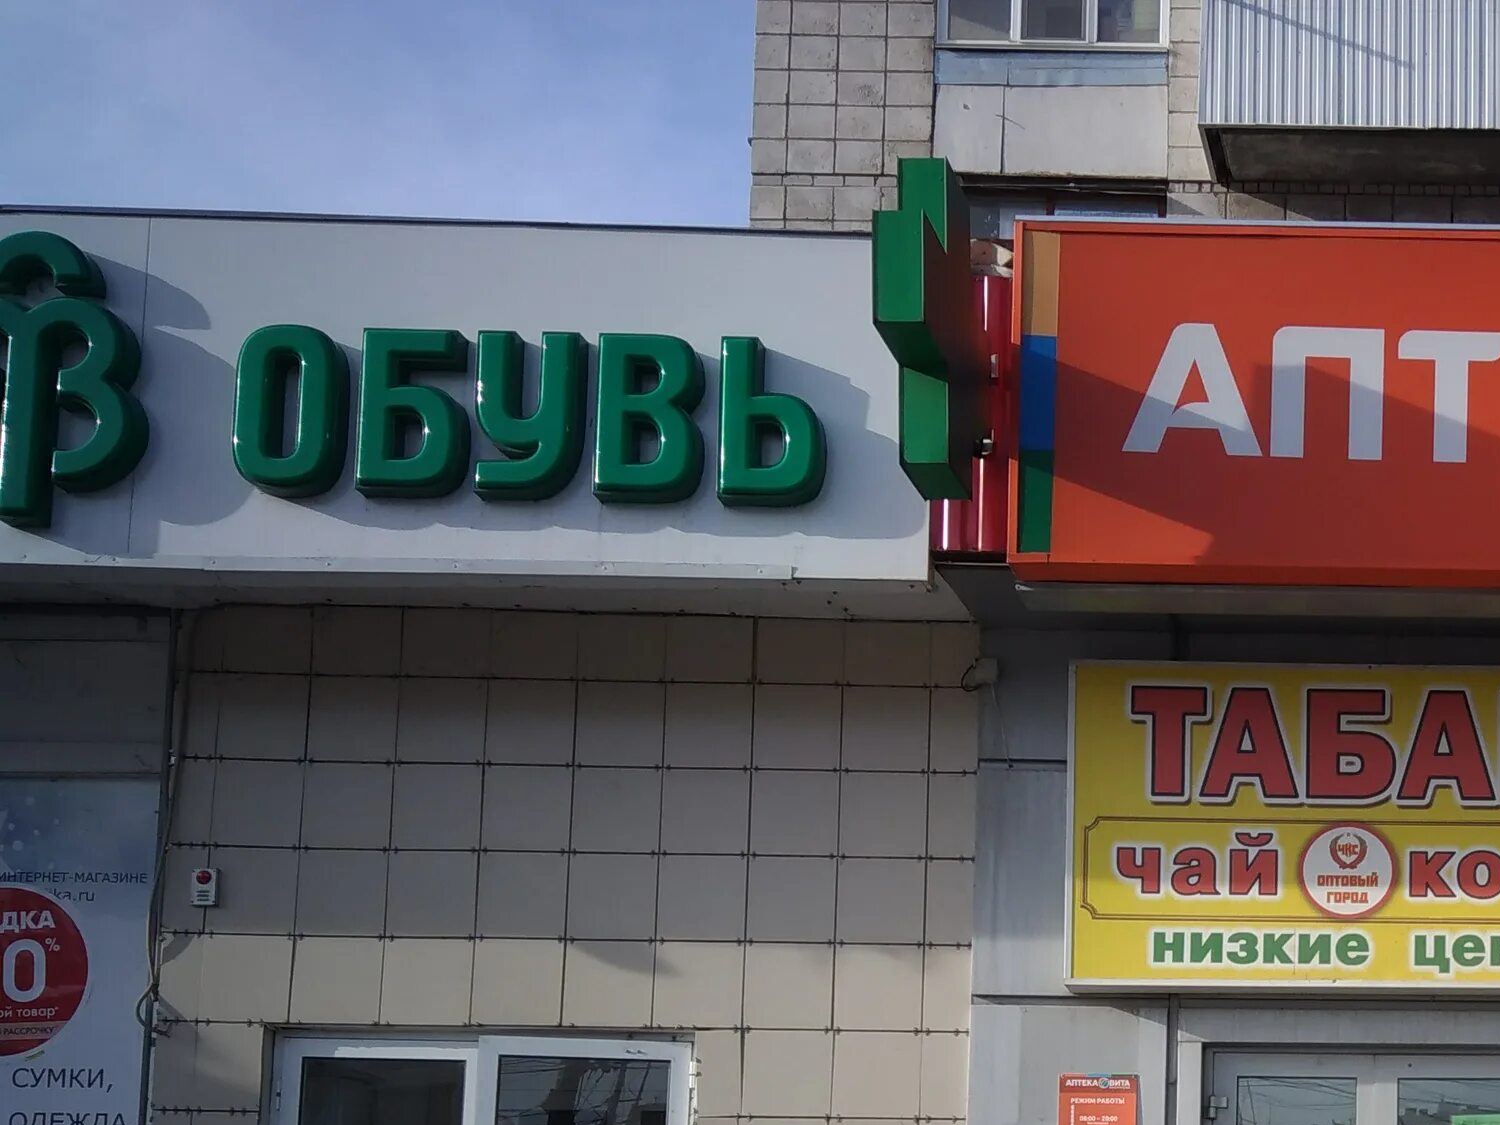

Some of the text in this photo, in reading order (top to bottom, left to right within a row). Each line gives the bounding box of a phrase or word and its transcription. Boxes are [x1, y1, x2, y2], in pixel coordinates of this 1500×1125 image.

[233, 325, 826, 506] ОБУВЬ
[1116, 832, 1280, 897] чай
[1317, 872, 1379, 887] ОПТОВЫЙ
[1326, 892, 1369, 904] ГОРОД
[1152, 930, 1370, 966] низкие
[12, 1068, 113, 1093] СУМКИ,
[1065, 1079, 1098, 1087] АПТЕКА
